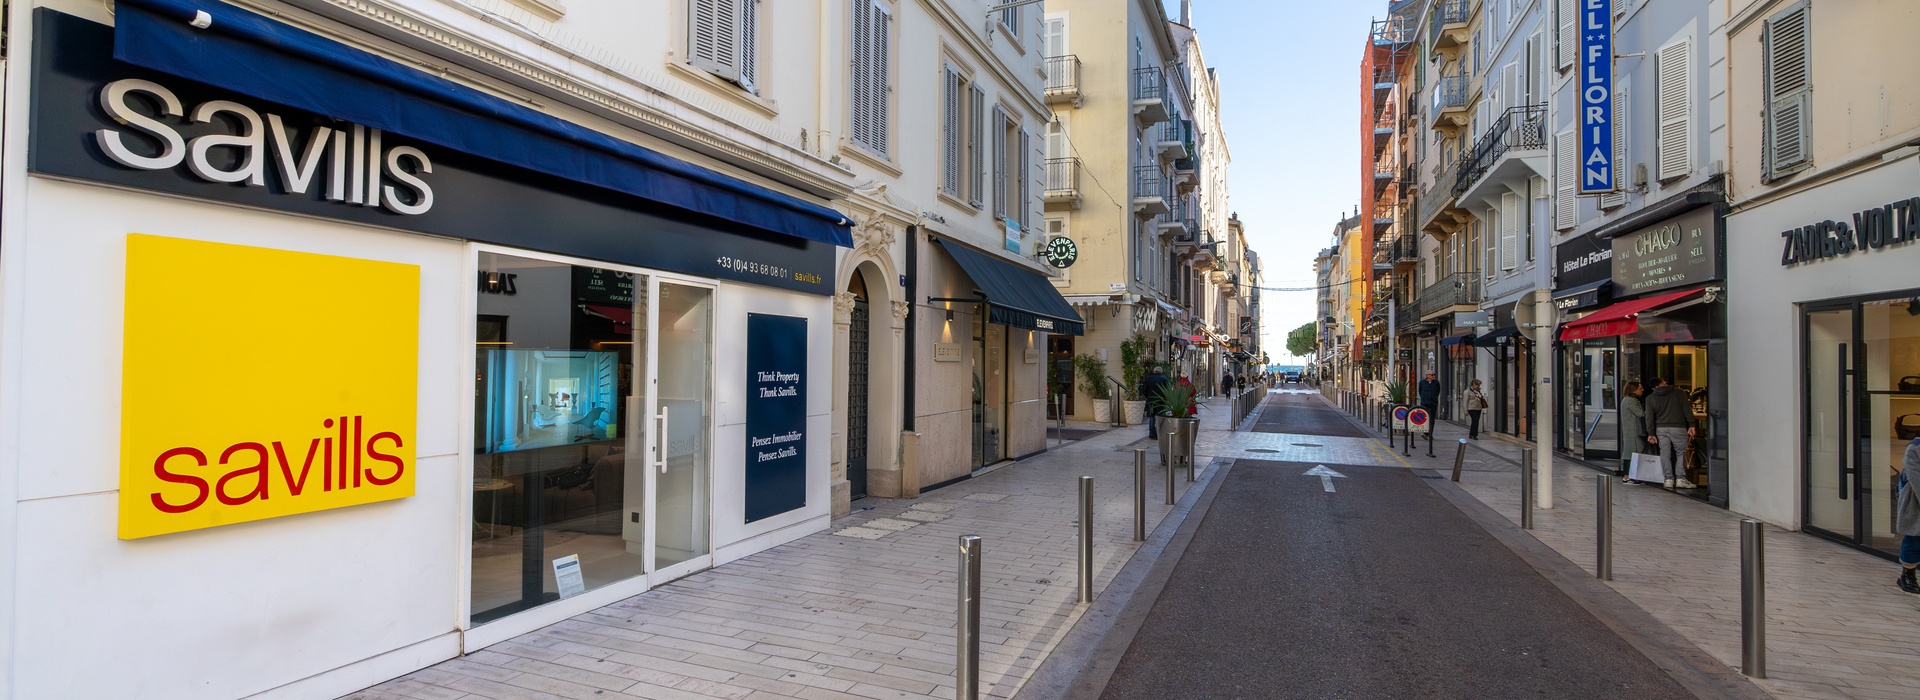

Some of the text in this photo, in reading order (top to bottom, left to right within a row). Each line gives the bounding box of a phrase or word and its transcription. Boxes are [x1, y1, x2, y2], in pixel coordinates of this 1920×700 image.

[1585, 45, 1608, 186] FLORIAN
[96, 78, 434, 216] savills
[1047, 237, 1076, 262] ELEVENPARIS
[1635, 222, 1682, 257] CHACO
[1690, 246, 1704, 257] SELL
[717, 256, 822, 285] +33 (0)4 93 68 08 01 savills.fr
[1563, 248, 1612, 273] Hôtel Le Florian
[757, 371, 800, 384] Think Property
[759, 386, 777, 398] Think
[751, 430, 802, 448] Pensez Immobilier
[150, 415, 404, 514] savills
[758, 451, 778, 463] Pensez
